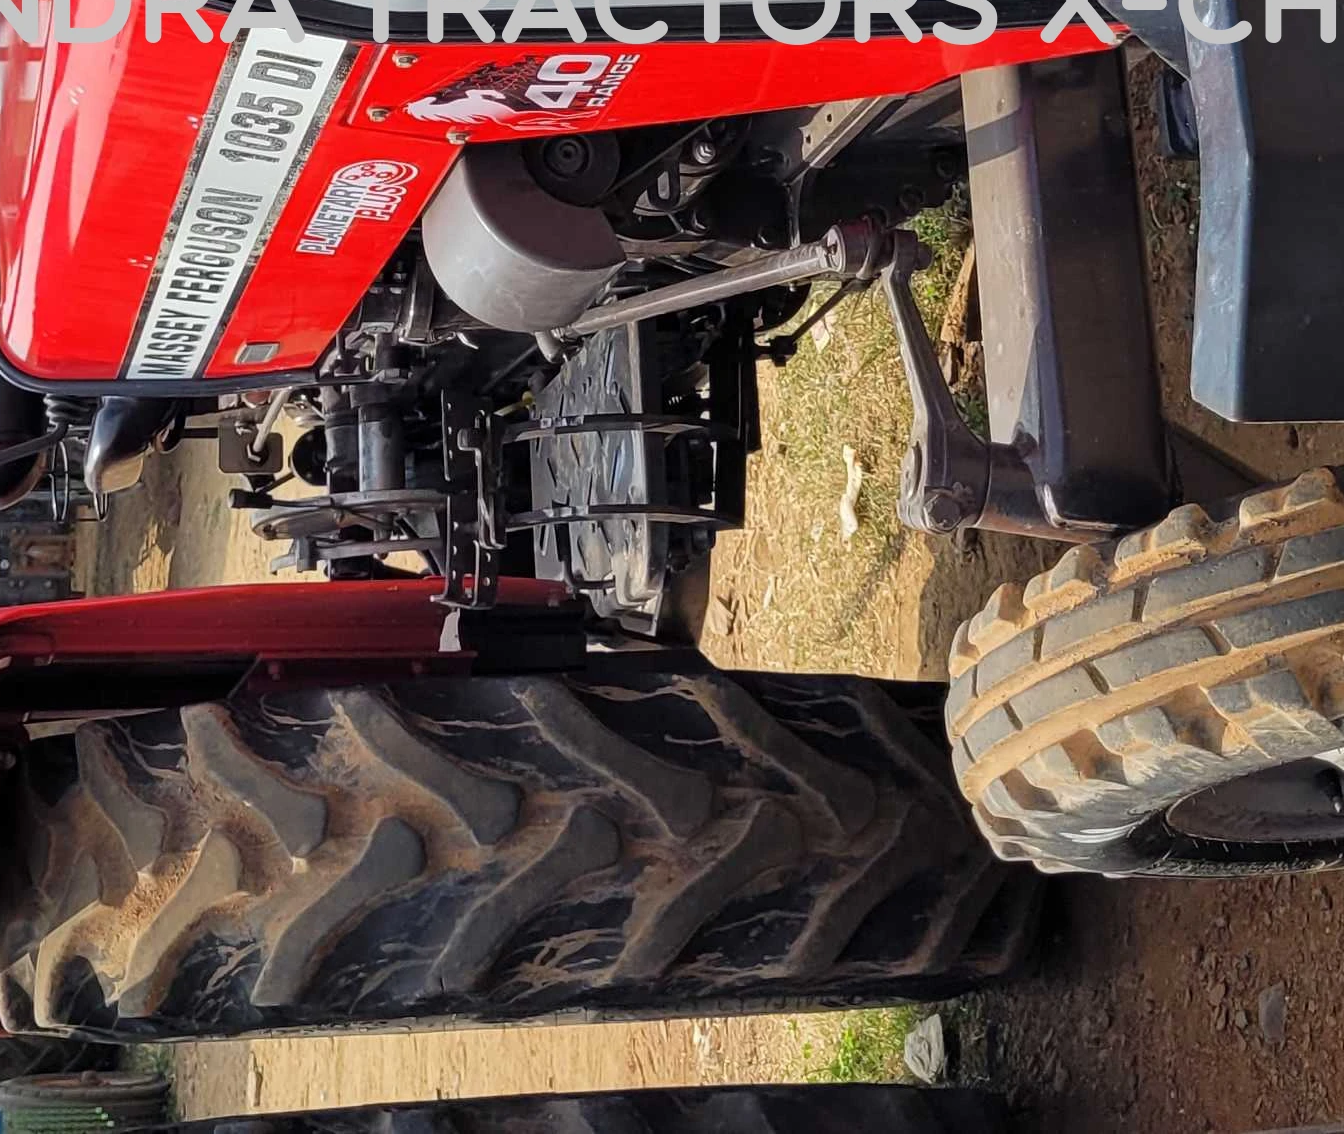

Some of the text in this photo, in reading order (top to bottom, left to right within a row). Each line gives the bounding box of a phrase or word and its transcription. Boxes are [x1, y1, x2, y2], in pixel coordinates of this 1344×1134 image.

[524, 54, 611, 108] 40
[586, 54, 641, 107] RANGE
[137, 49, 323, 376] MASSEY FERGUSON 1035 DI
[296, 179, 368, 254] PLANETARY
[355, 184, 407, 220] PLUS
